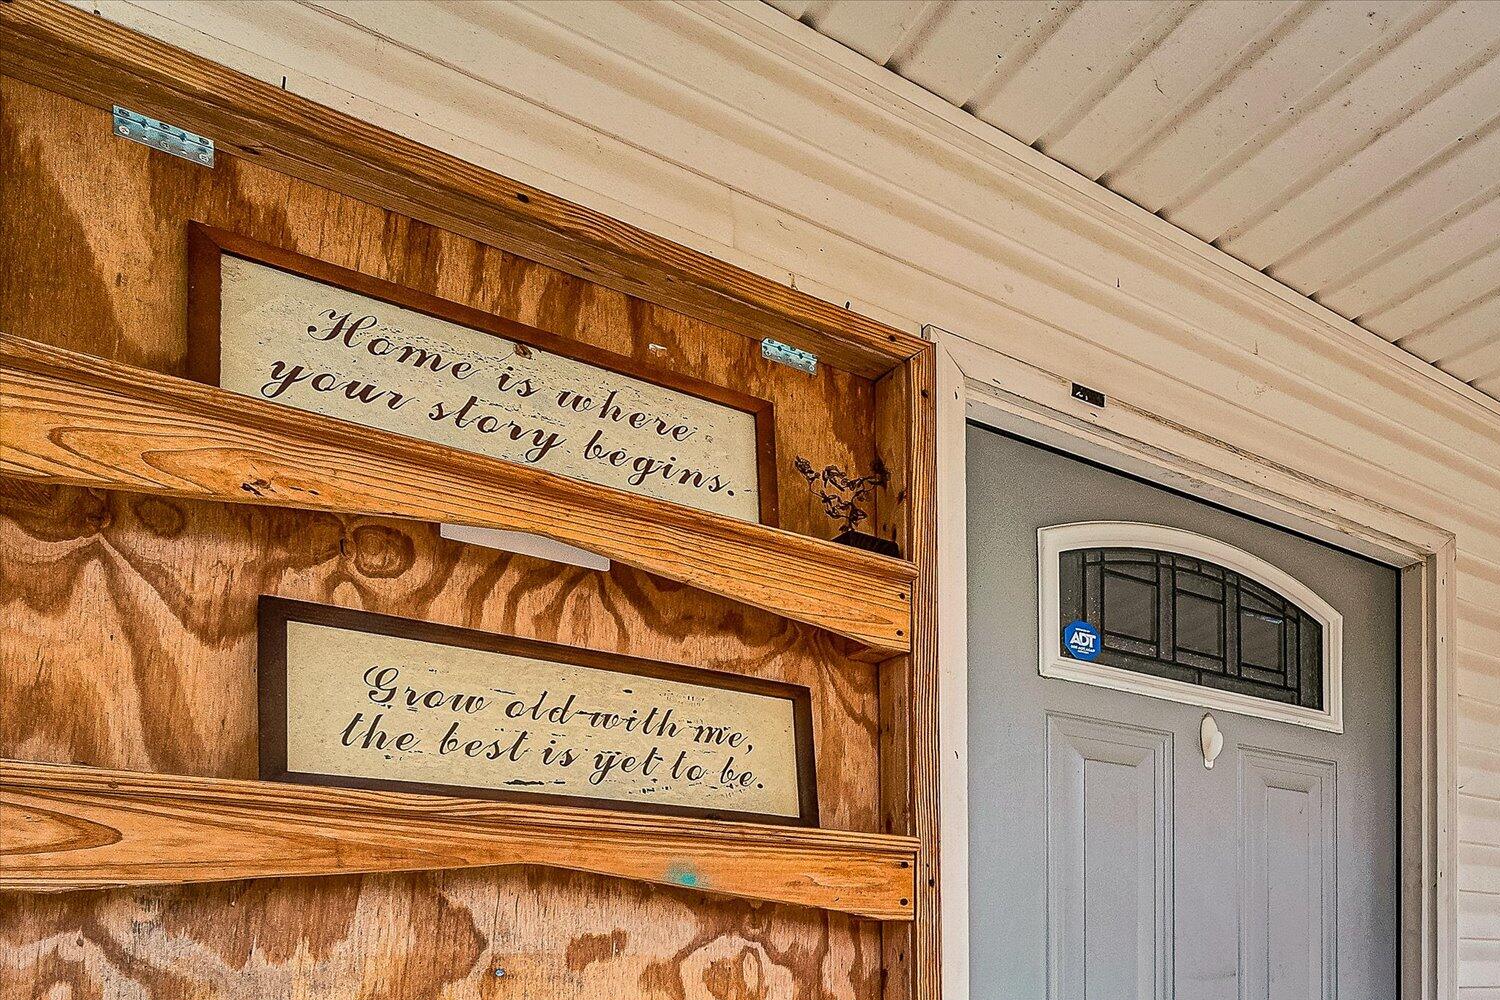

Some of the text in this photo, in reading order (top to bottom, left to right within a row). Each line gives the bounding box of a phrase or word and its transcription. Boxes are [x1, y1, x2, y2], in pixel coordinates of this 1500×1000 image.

[307, 308, 695, 443] Home is where
[260, 360, 735, 497] your story begins.
[1069, 631, 1097, 648] ADT
[340, 712, 764, 790] the best is yet to be.
[363, 665, 753, 756] Grow old with me,
